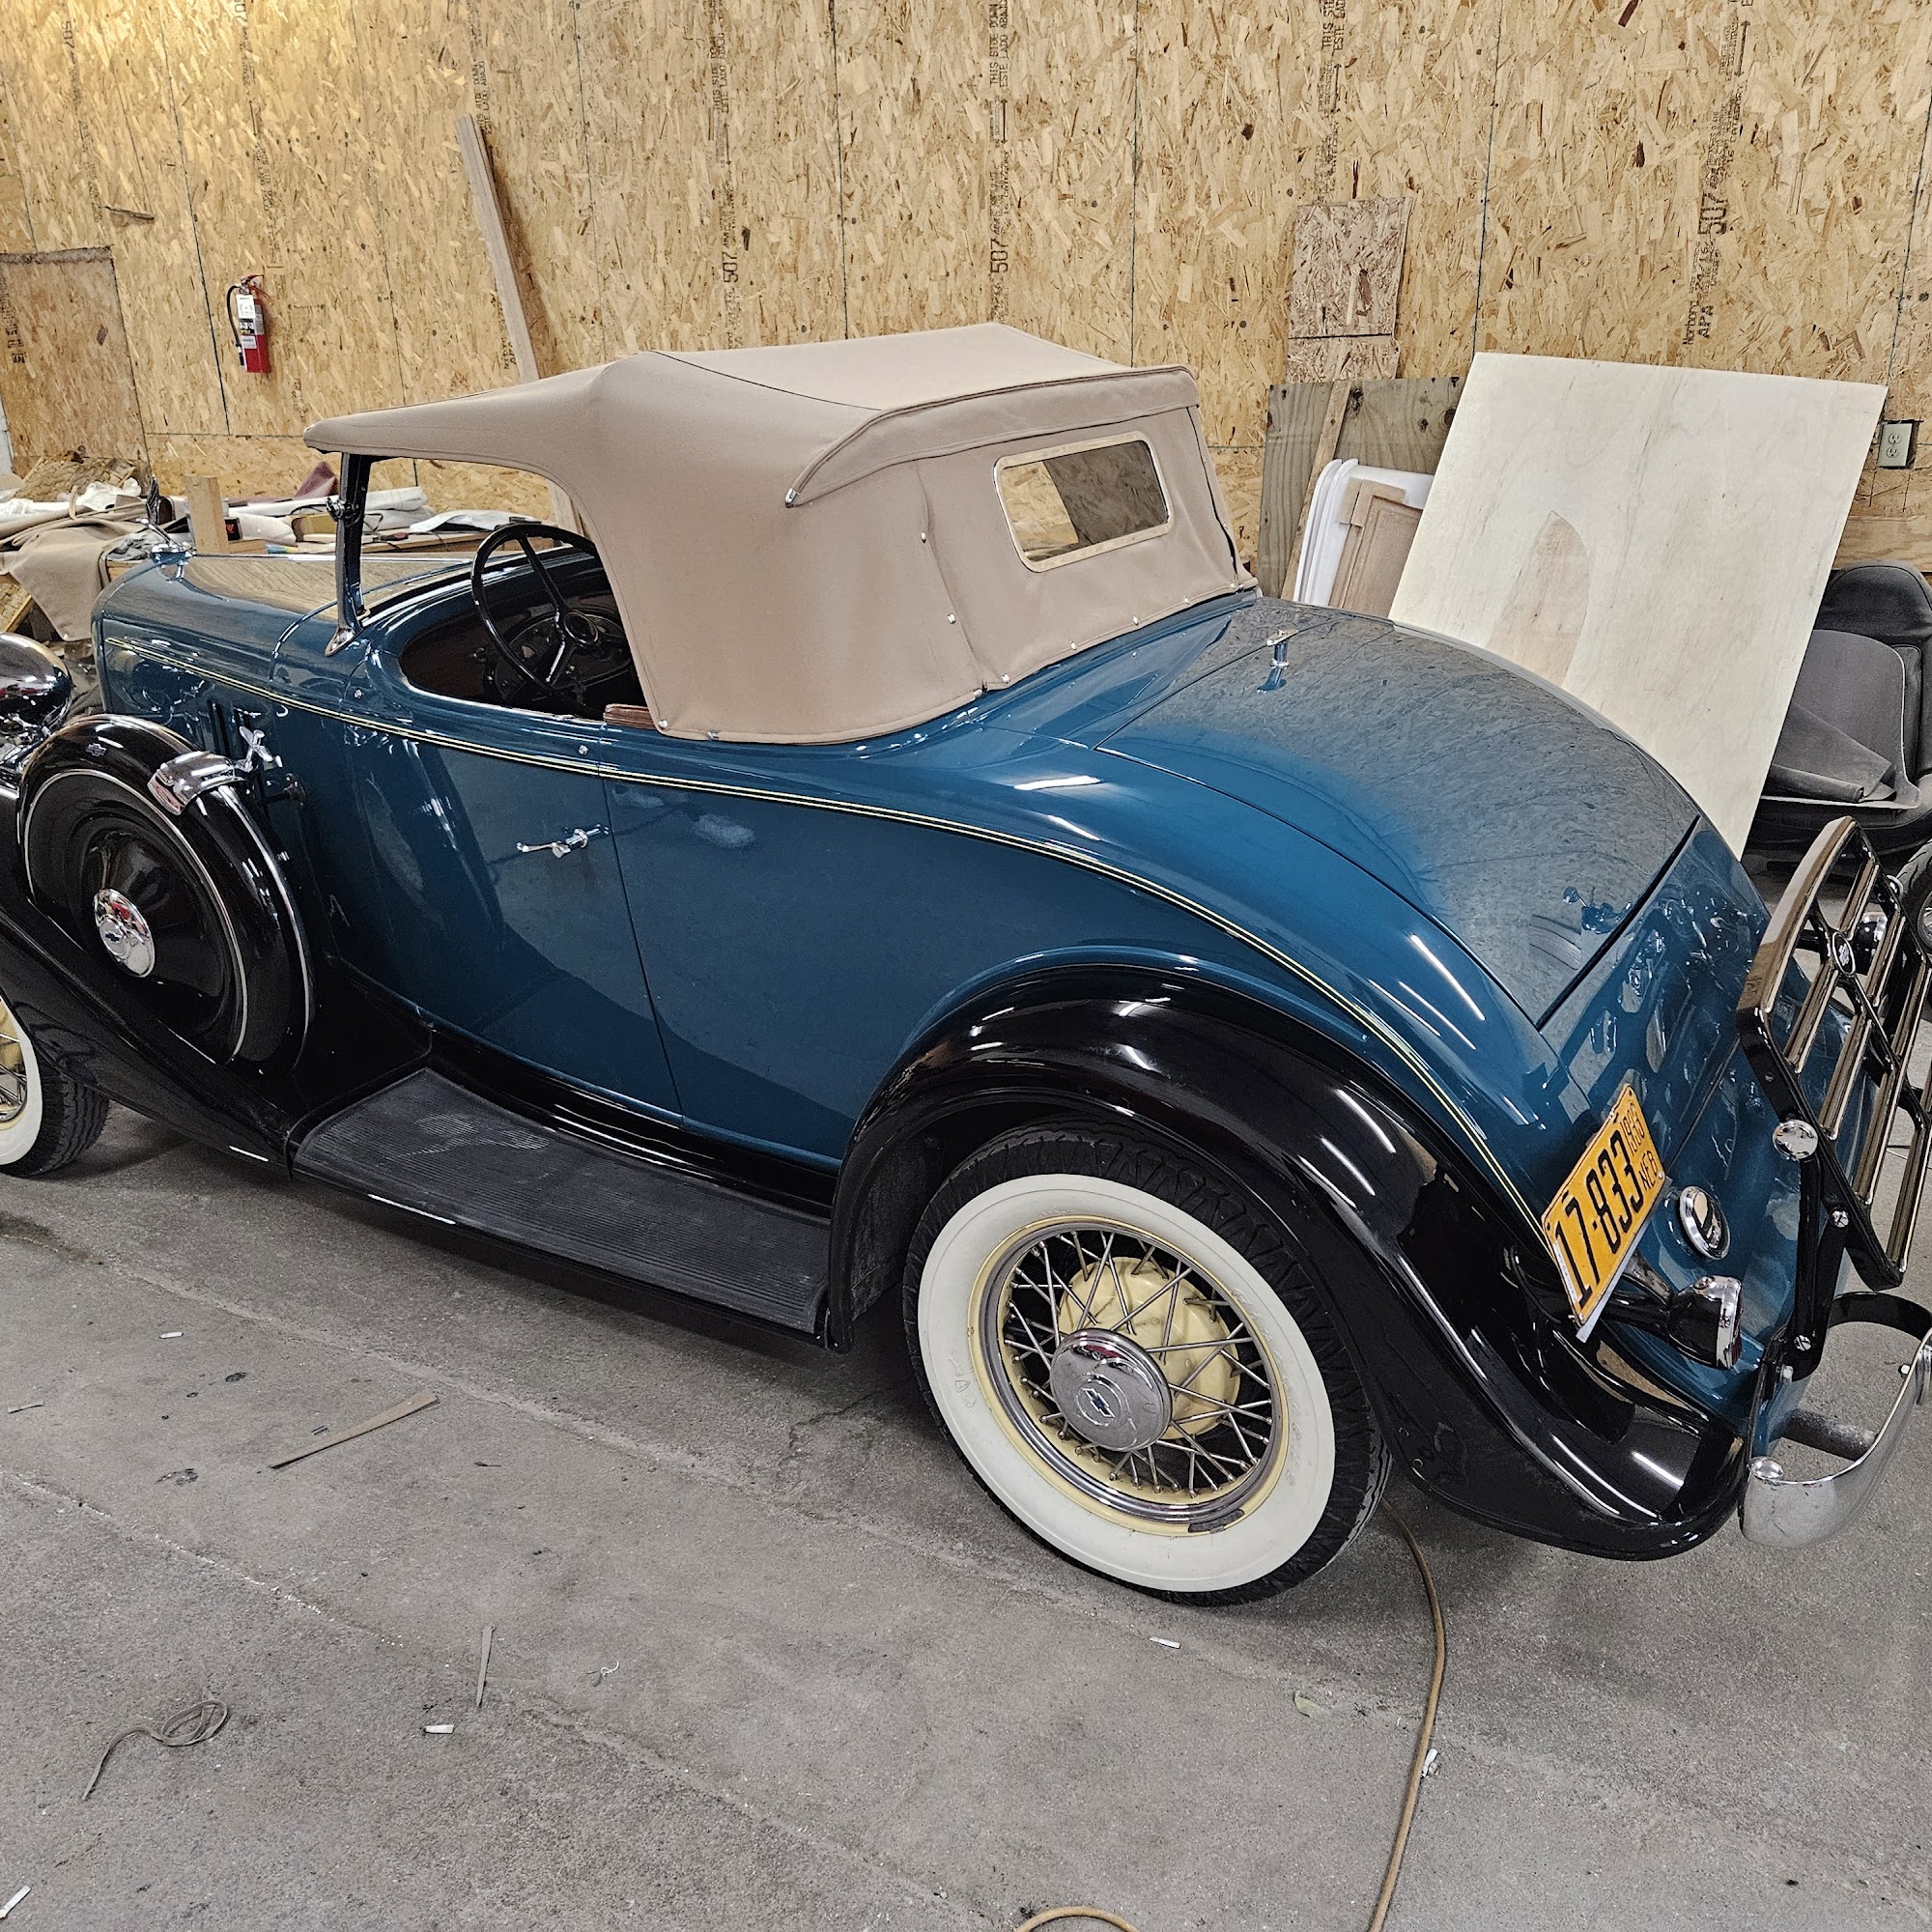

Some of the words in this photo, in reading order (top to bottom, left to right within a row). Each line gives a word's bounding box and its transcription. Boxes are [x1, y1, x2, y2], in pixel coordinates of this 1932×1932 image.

[989, 33, 999, 57] SIDE
[999, 34, 1009, 59] LADO
[1321, 23, 1333, 48] THIS
[1333, 24, 1345, 50] ESTE
[989, 62, 999, 86] THIS
[999, 63, 1009, 88] ESTE
[1698, 192, 1728, 235] 507
[722, 251, 739, 283] 507
[990, 238, 1009, 273] 507
[1696, 305, 1714, 339] APA
[1619, 1102, 1645, 1156] 1933
[1638, 1150, 1659, 1192] NEB
[1555, 1128, 1644, 1310] 17-833
